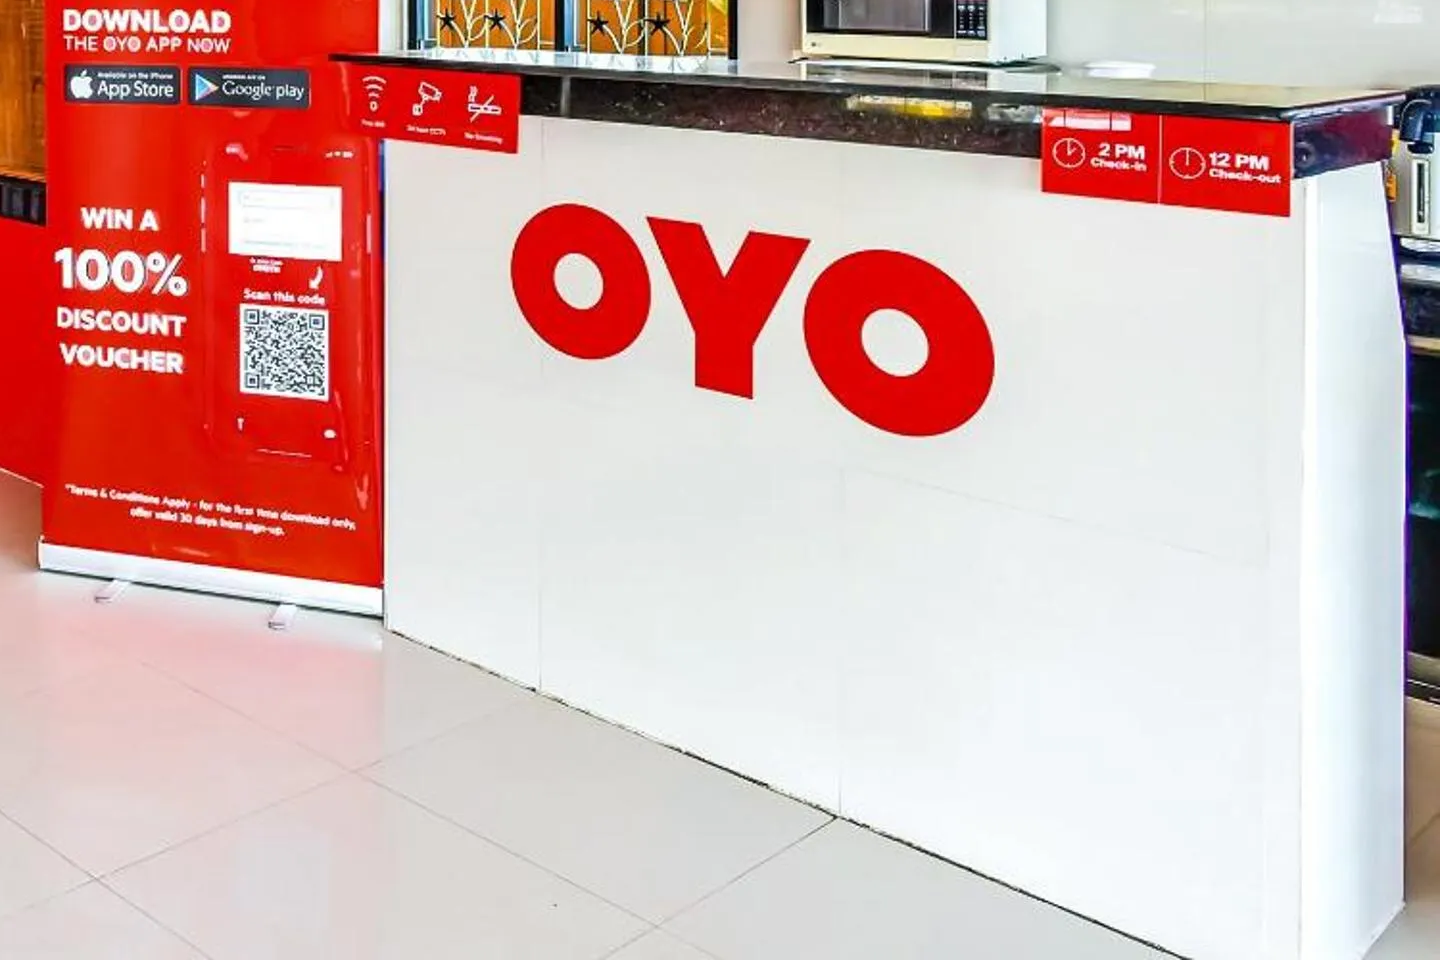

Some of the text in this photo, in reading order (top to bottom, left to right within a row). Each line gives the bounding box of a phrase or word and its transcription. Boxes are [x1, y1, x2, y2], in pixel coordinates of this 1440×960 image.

[63, 8, 232, 34] DOWNLOAD
[63, 35, 231, 54] THE OYO APP NOW
[96, 80, 174, 101] App Store
[221, 80, 305, 102] Google play
[1098, 143, 1146, 160] 2 PM
[1209, 151, 1270, 172] 12 PM
[1090, 156, 1147, 172] Check-in
[1208, 168, 1282, 184] Check-out
[80, 207, 159, 232] WIN A
[54, 247, 189, 297] 100%
[243, 287, 326, 307] Scan this code
[56, 306, 188, 337] DISCOUNT
[510, 203, 995, 438] OYO
[59, 343, 184, 375] VOUCHER
